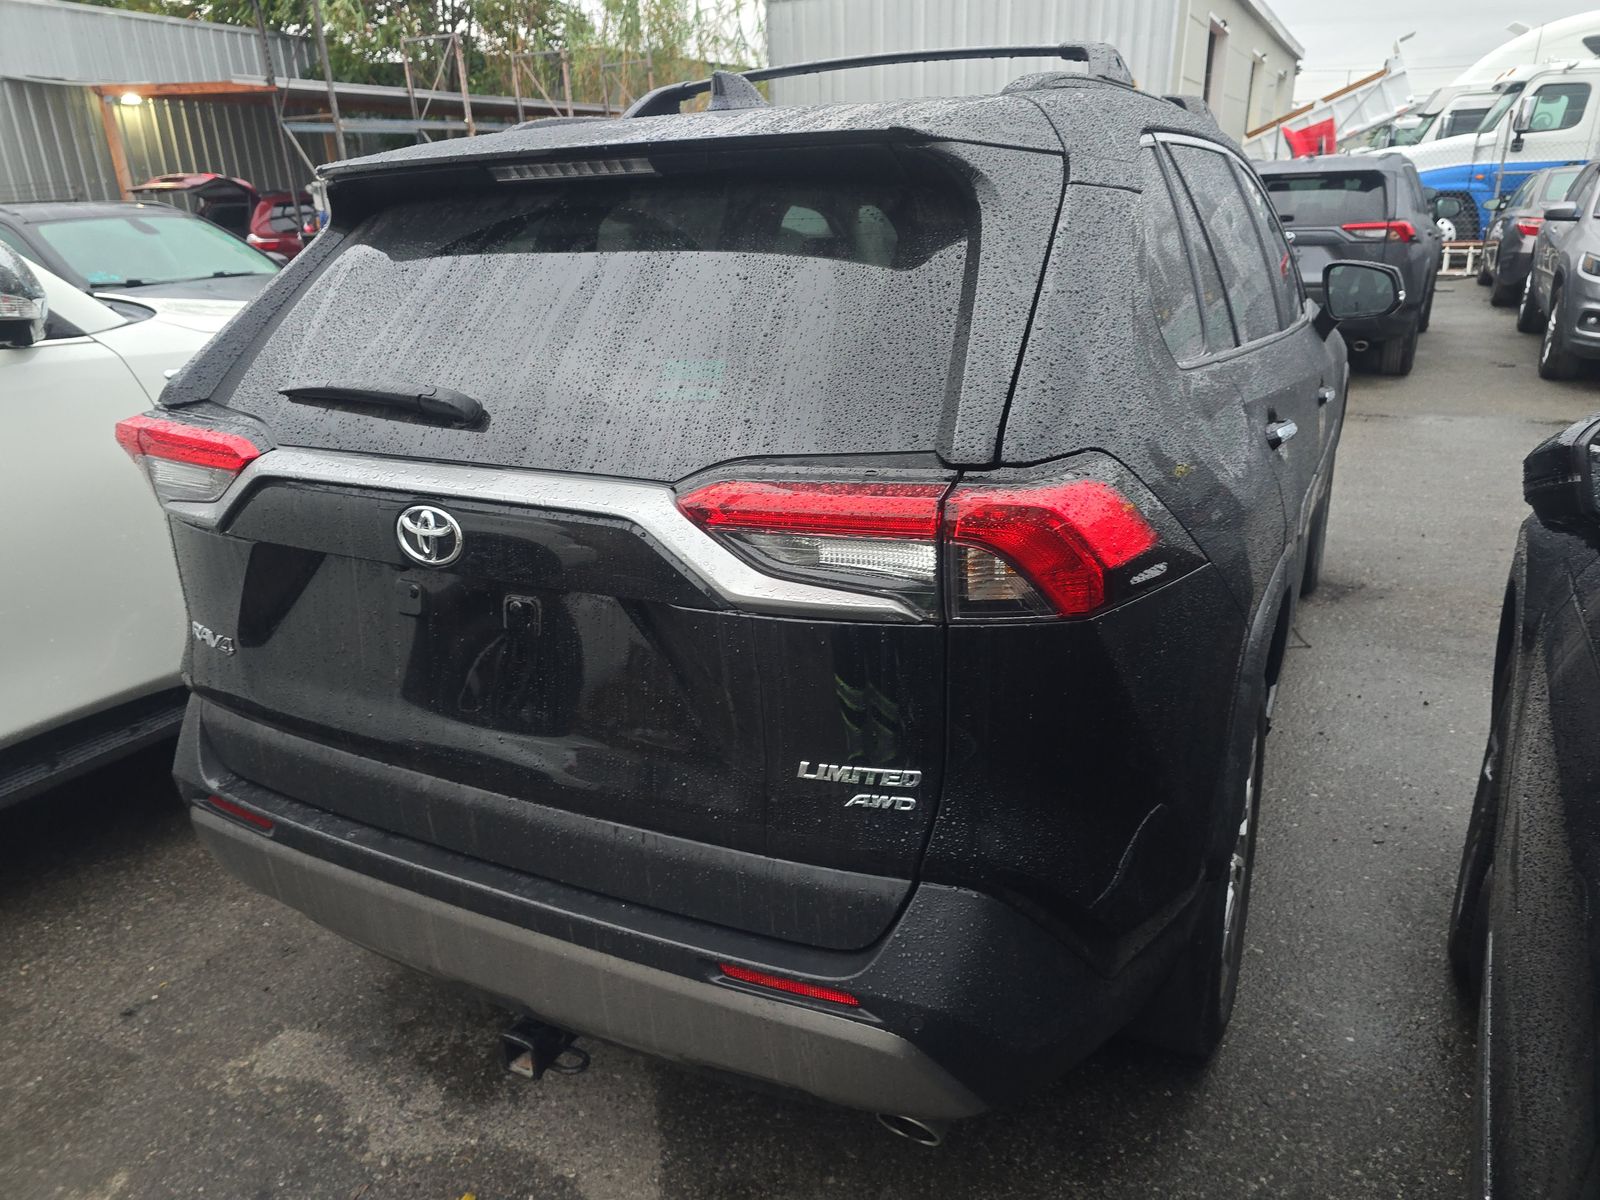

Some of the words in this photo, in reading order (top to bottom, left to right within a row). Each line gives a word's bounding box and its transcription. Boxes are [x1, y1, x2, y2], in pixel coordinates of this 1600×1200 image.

[191, 620, 235, 656] RAV4
[797, 760, 922, 787] LIMITED
[844, 794, 917, 811] AWD
